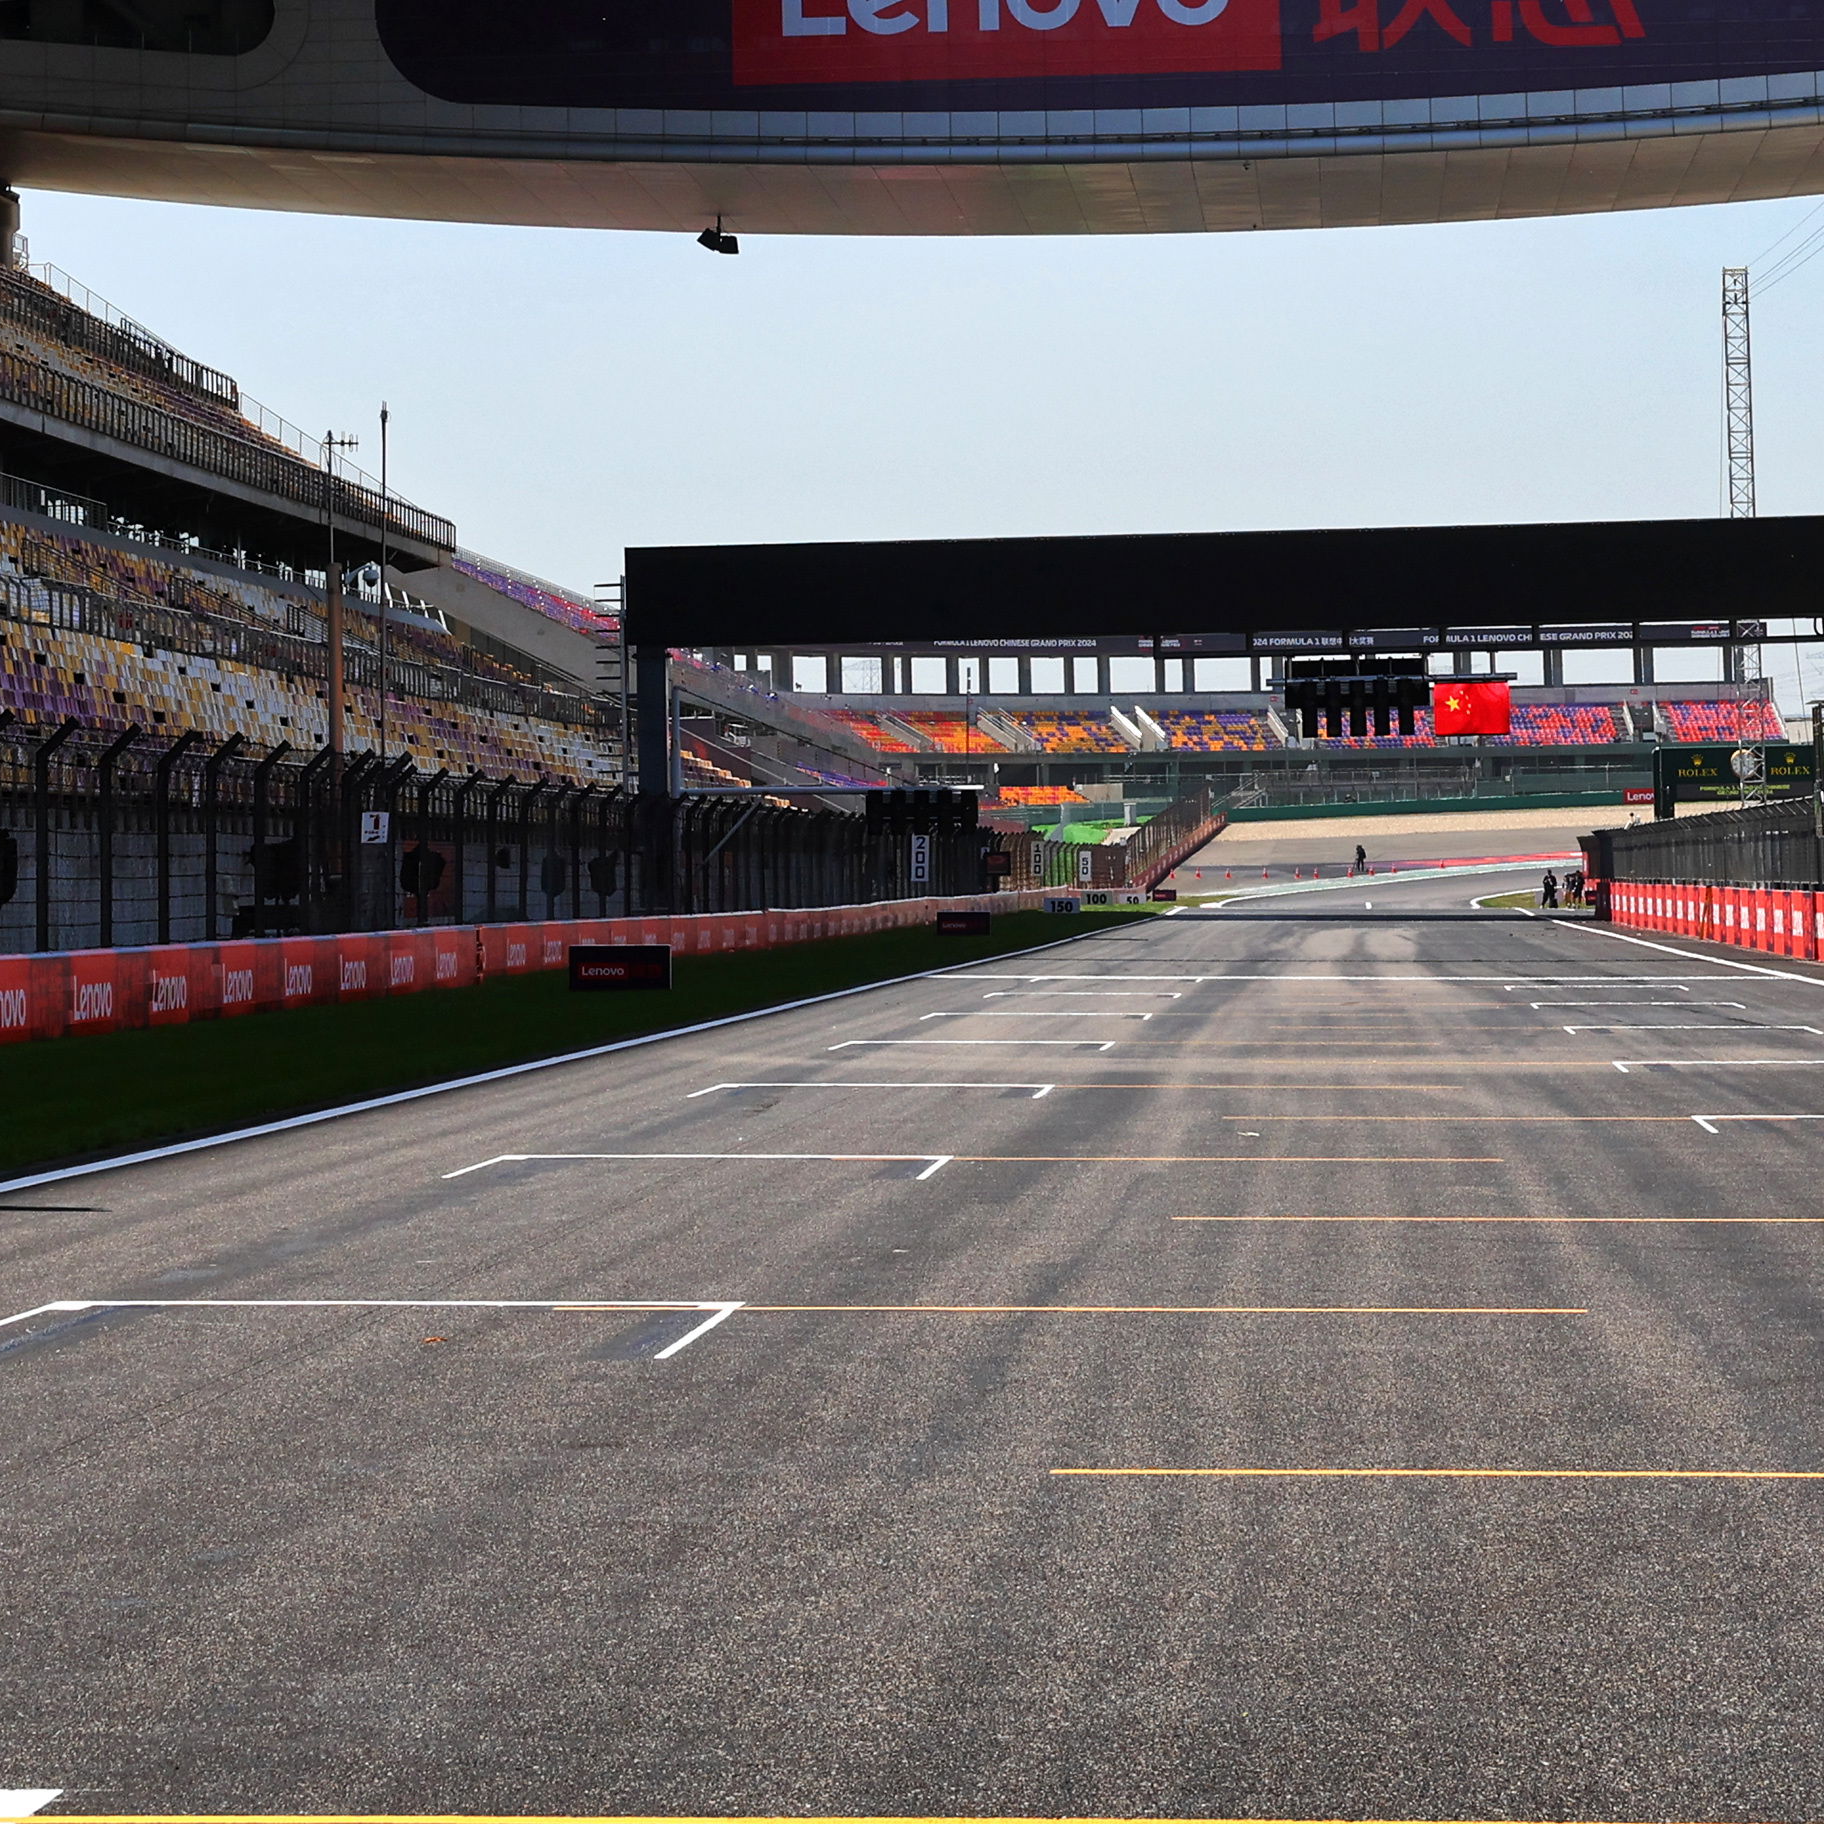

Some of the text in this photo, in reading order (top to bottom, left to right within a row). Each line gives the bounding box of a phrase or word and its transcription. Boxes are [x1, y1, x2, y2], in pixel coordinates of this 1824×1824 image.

[1269, 637, 1313, 646] FORMULA
[1477, 633, 1516, 643] LENOVO
[1559, 631, 1593, 641] GRAND
[1594, 631, 1616, 640] PRIX
[1678, 768, 1718, 777] ROLEX
[1770, 766, 1810, 775] ROLEX
[915, 835, 926, 880] 200
[1033, 843, 1042, 875] 100
[1081, 857, 1089, 875] 50
[1050, 900, 1073, 913] 150
[1086, 893, 1107, 905] 100
[1126, 896, 1139, 905] 50
[283, 957, 313, 997] Lenovo
[339, 953, 367, 991] Lenovo
[581, 965, 625, 976] Lenovo
[151, 968, 187, 1013] Lenovo
[221, 962, 254, 1004] Lenovo
[73, 975, 113, 1021] Lenovo
